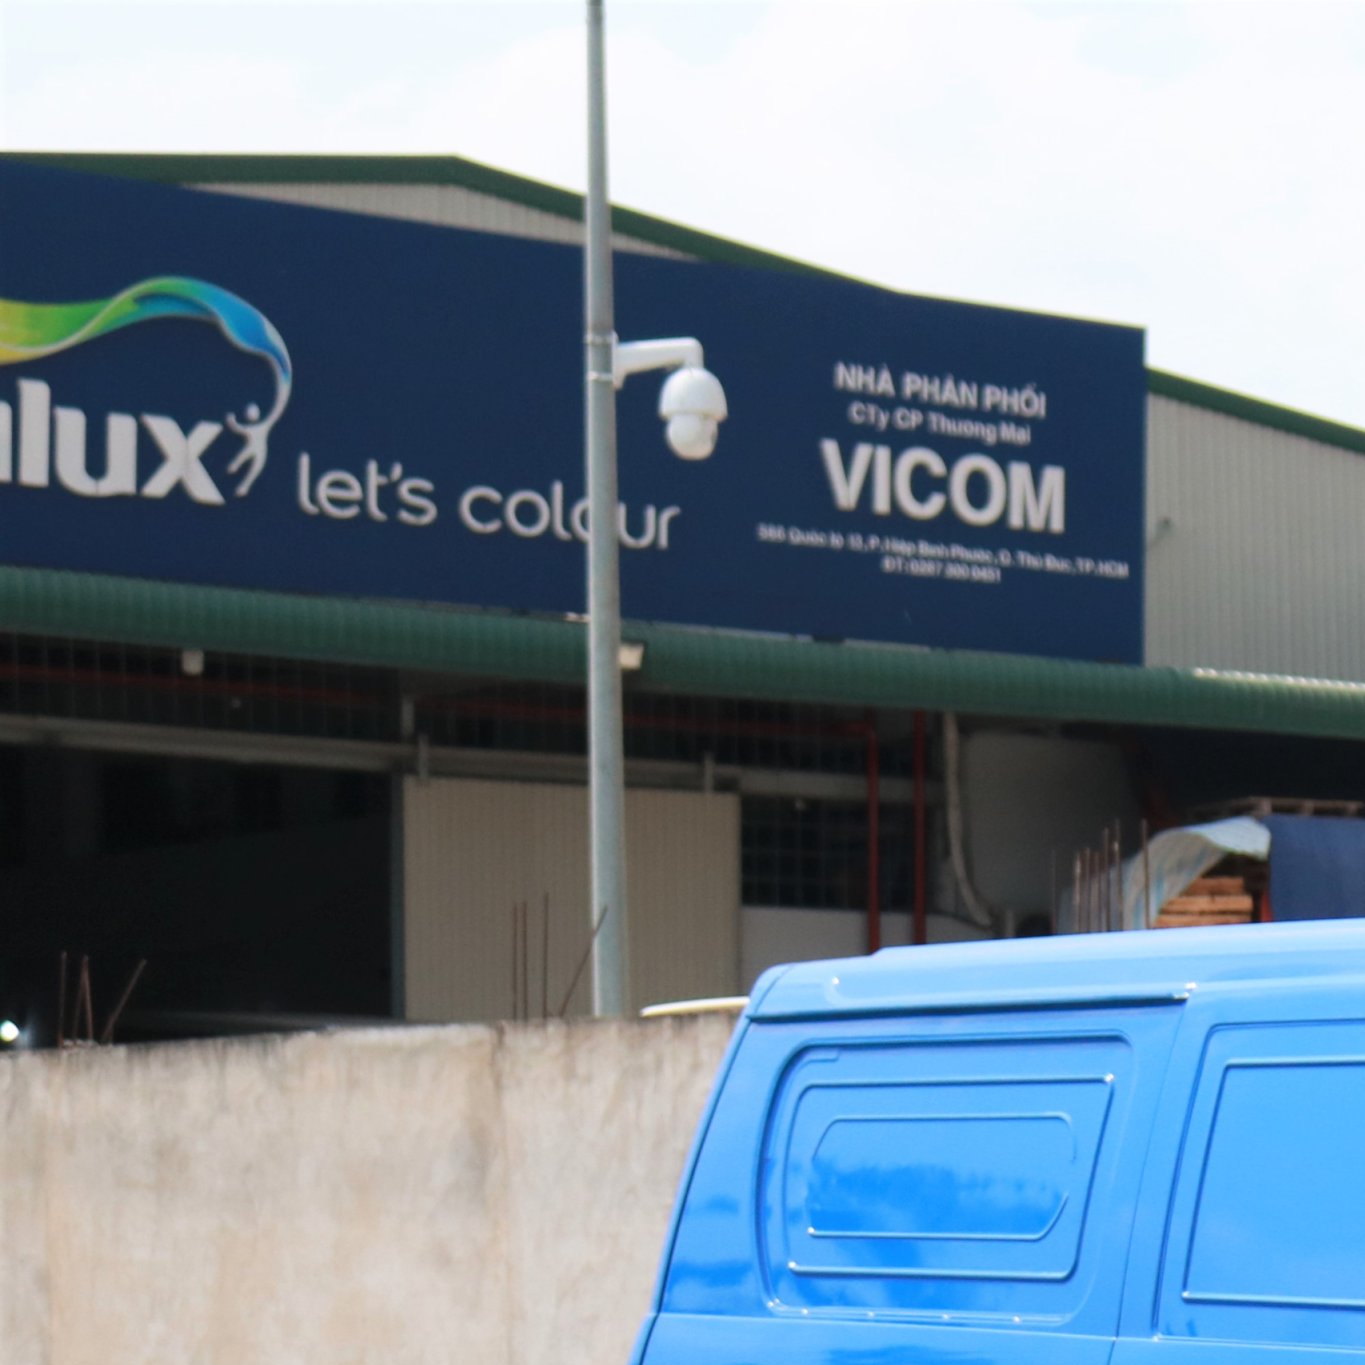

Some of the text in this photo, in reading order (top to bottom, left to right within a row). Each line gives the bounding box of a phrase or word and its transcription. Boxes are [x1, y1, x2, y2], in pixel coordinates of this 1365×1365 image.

[0, 377, 227, 506] lux
[893, 406, 923, 432] CP
[298, 451, 438, 526] let's
[820, 437, 1067, 536] VICOM
